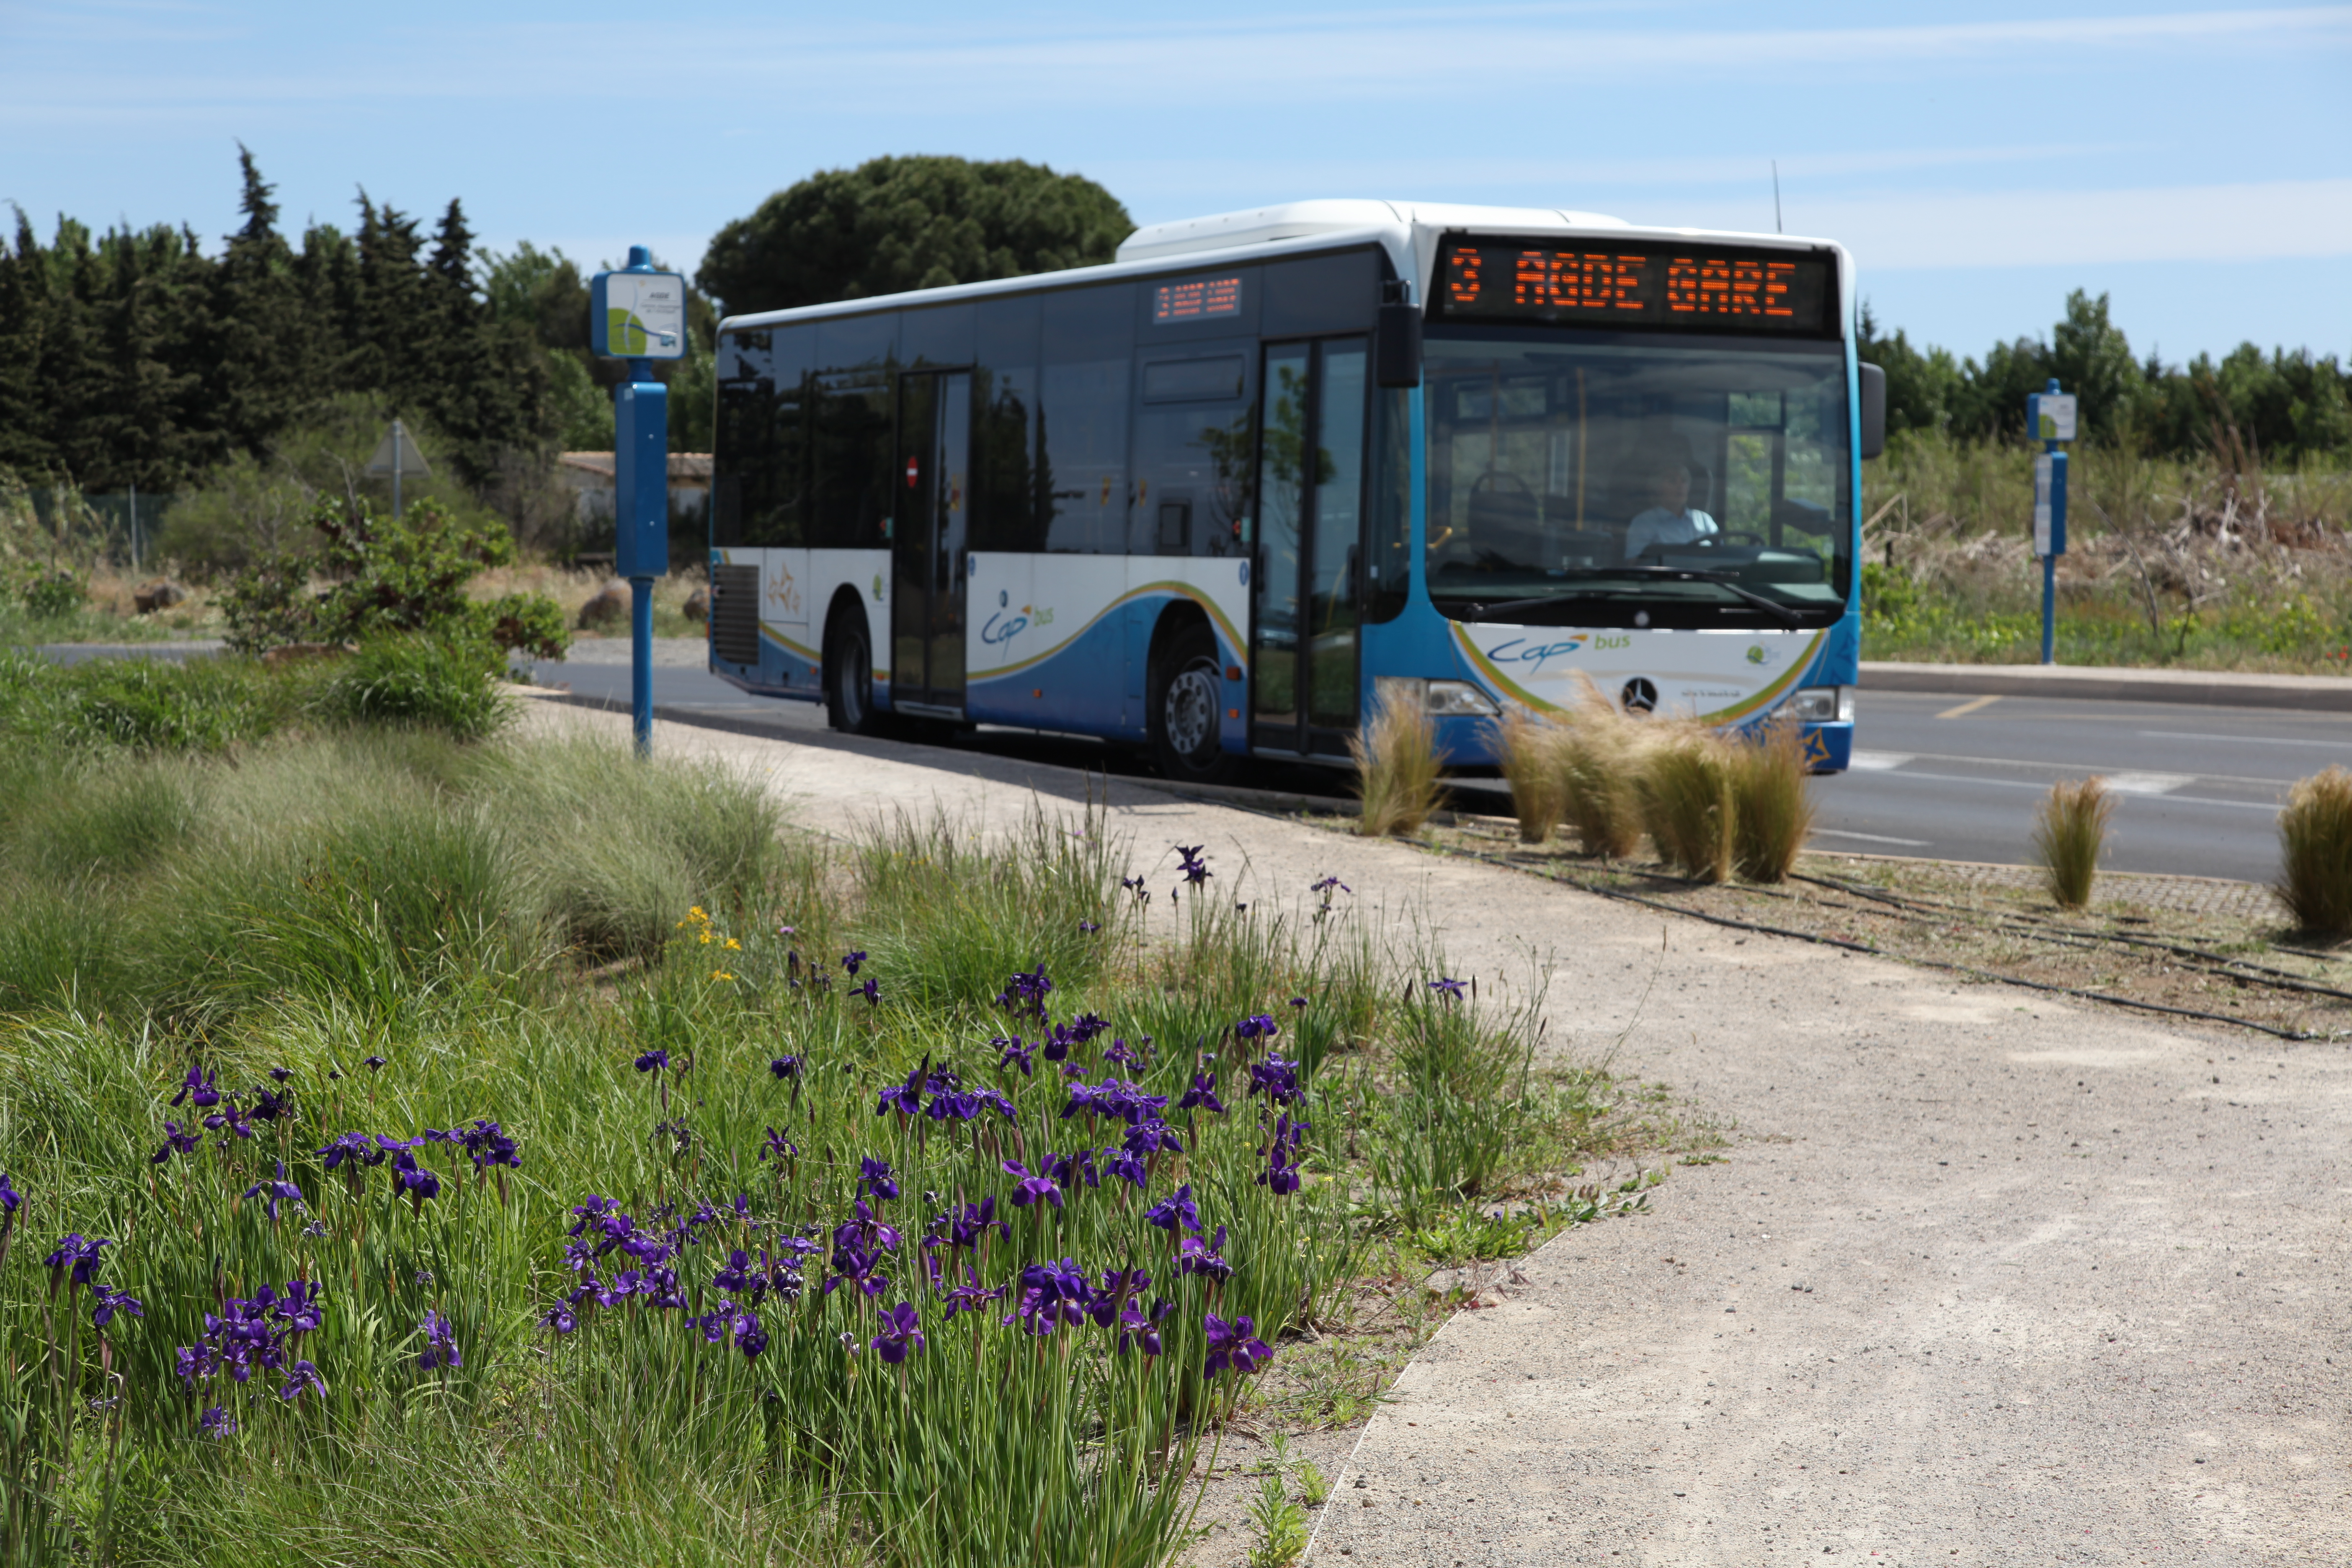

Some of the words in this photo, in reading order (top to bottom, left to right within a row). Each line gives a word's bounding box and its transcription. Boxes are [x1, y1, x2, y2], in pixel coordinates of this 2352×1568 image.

[1451, 248, 1482, 302] 3
[1515, 251, 1646, 309] AGDE
[1667, 258, 1796, 316] GARE
[1033, 605, 1054, 627] bus
[1594, 634, 1631, 650] bus
